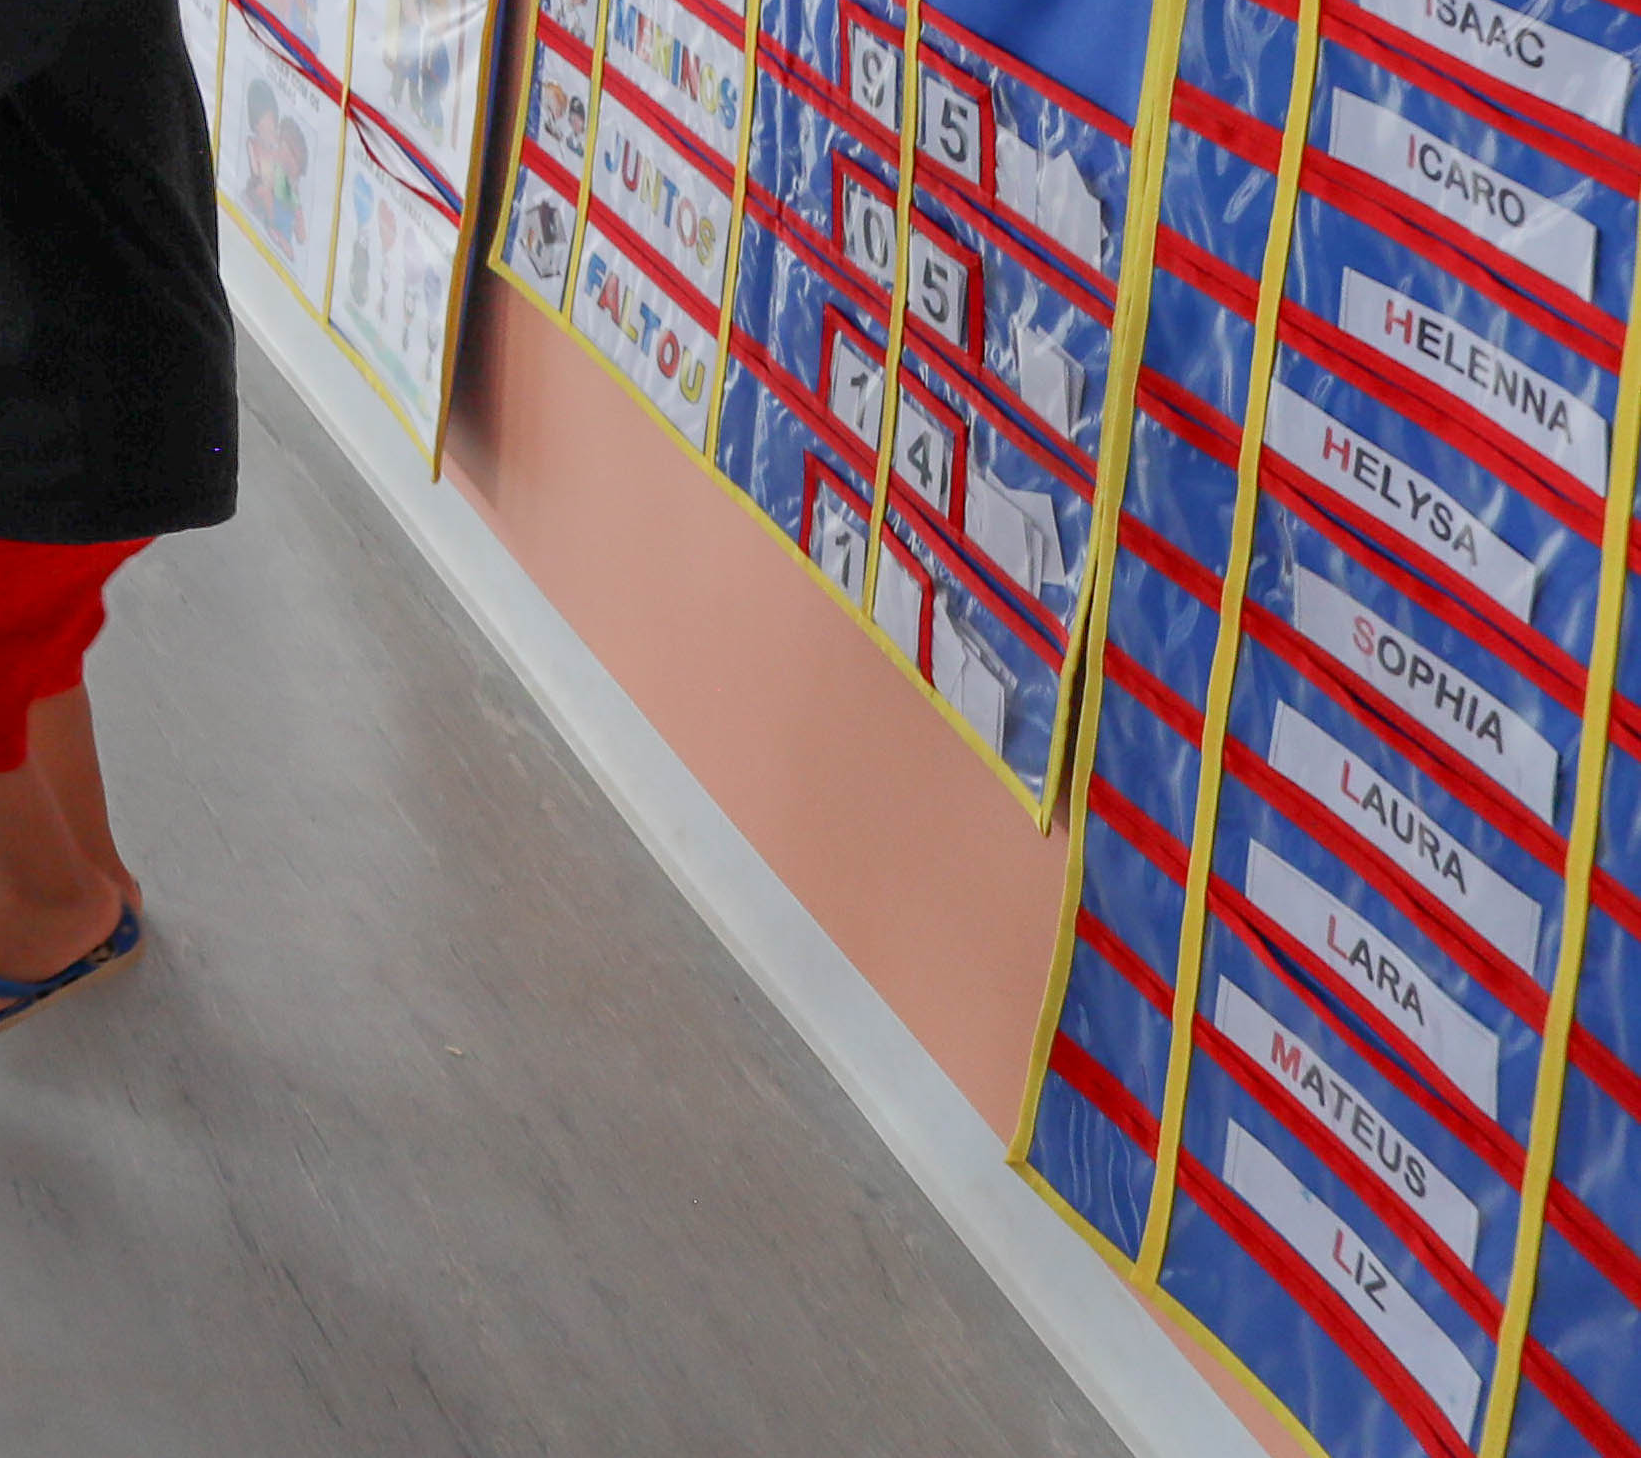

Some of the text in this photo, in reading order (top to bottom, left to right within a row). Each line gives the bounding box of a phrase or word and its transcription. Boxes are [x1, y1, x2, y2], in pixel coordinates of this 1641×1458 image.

[940, 97, 968, 163] 5
[1408, 134, 1525, 227] ICARO
[603, 129, 717, 269] JUNTOS
[583, 250, 706, 404] FALTOU
[921, 261, 949, 325] 5
[850, 371, 933, 489] 1 4
[1383, 298, 1574, 445] HELENNA
[835, 531, 852, 589] 1
[1322, 426, 1478, 567] HELYSA
[1352, 615, 1505, 755] SOPHIA
[1340, 760, 1468, 896] LAURA
[1326, 914, 1426, 1027] LARA
[1270, 1030, 1428, 1200] MATEUS
[1330, 1228, 1389, 1314] LIZ
